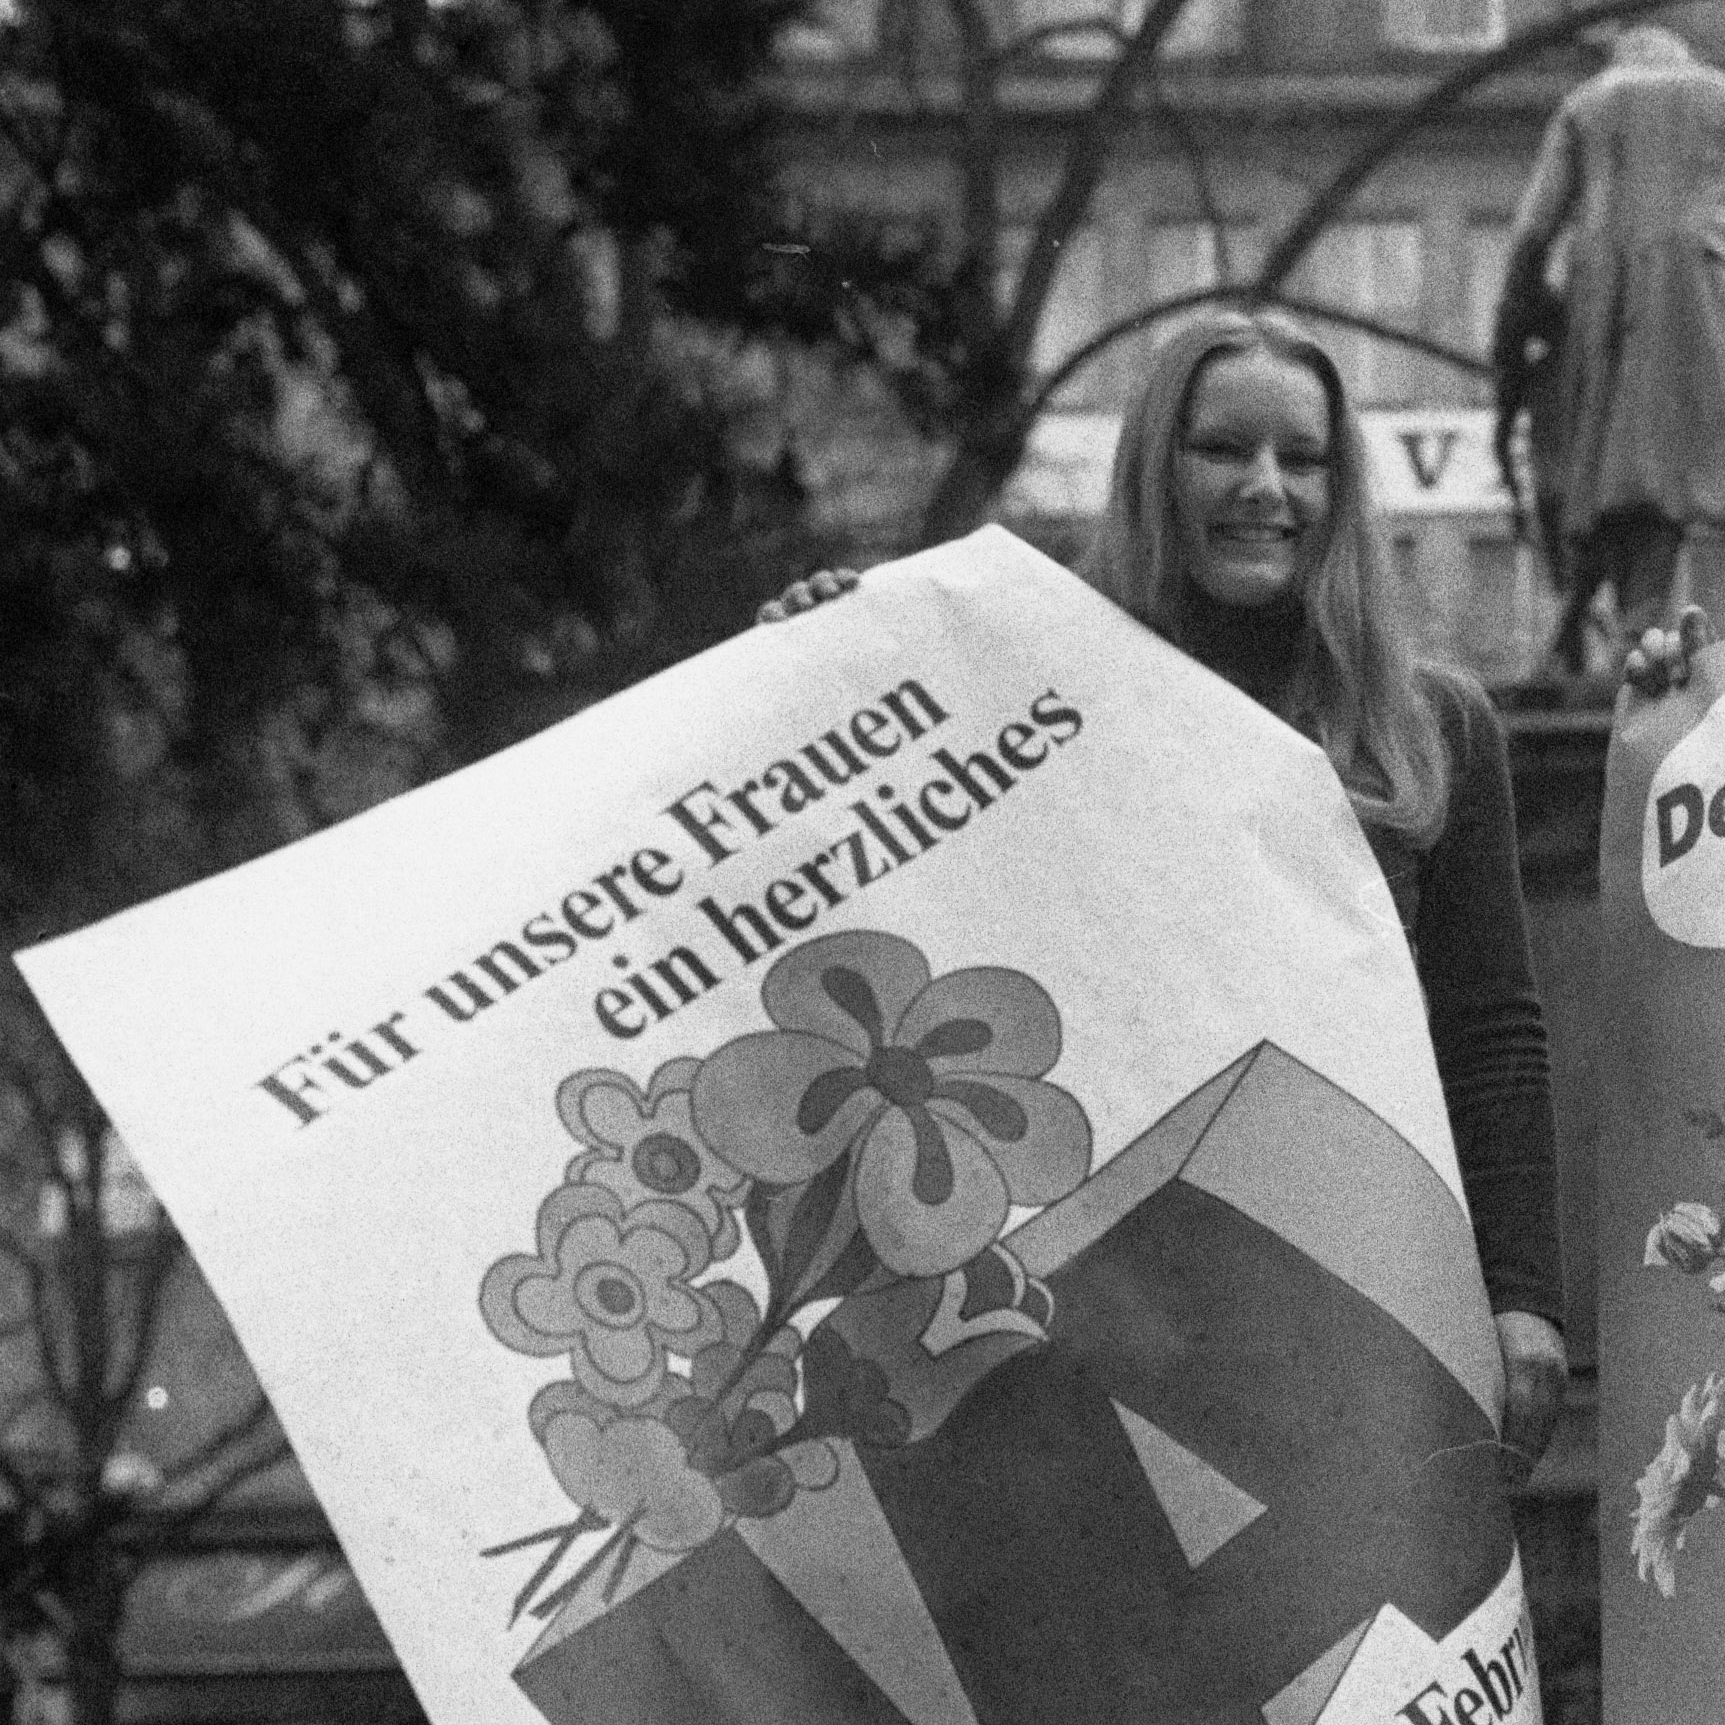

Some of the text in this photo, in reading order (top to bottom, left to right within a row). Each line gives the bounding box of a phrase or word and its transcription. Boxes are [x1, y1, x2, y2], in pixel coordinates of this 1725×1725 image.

[255, 676, 952, 1130] Für unsere Frauen
[592, 686, 1086, 1042] ein herzliches
